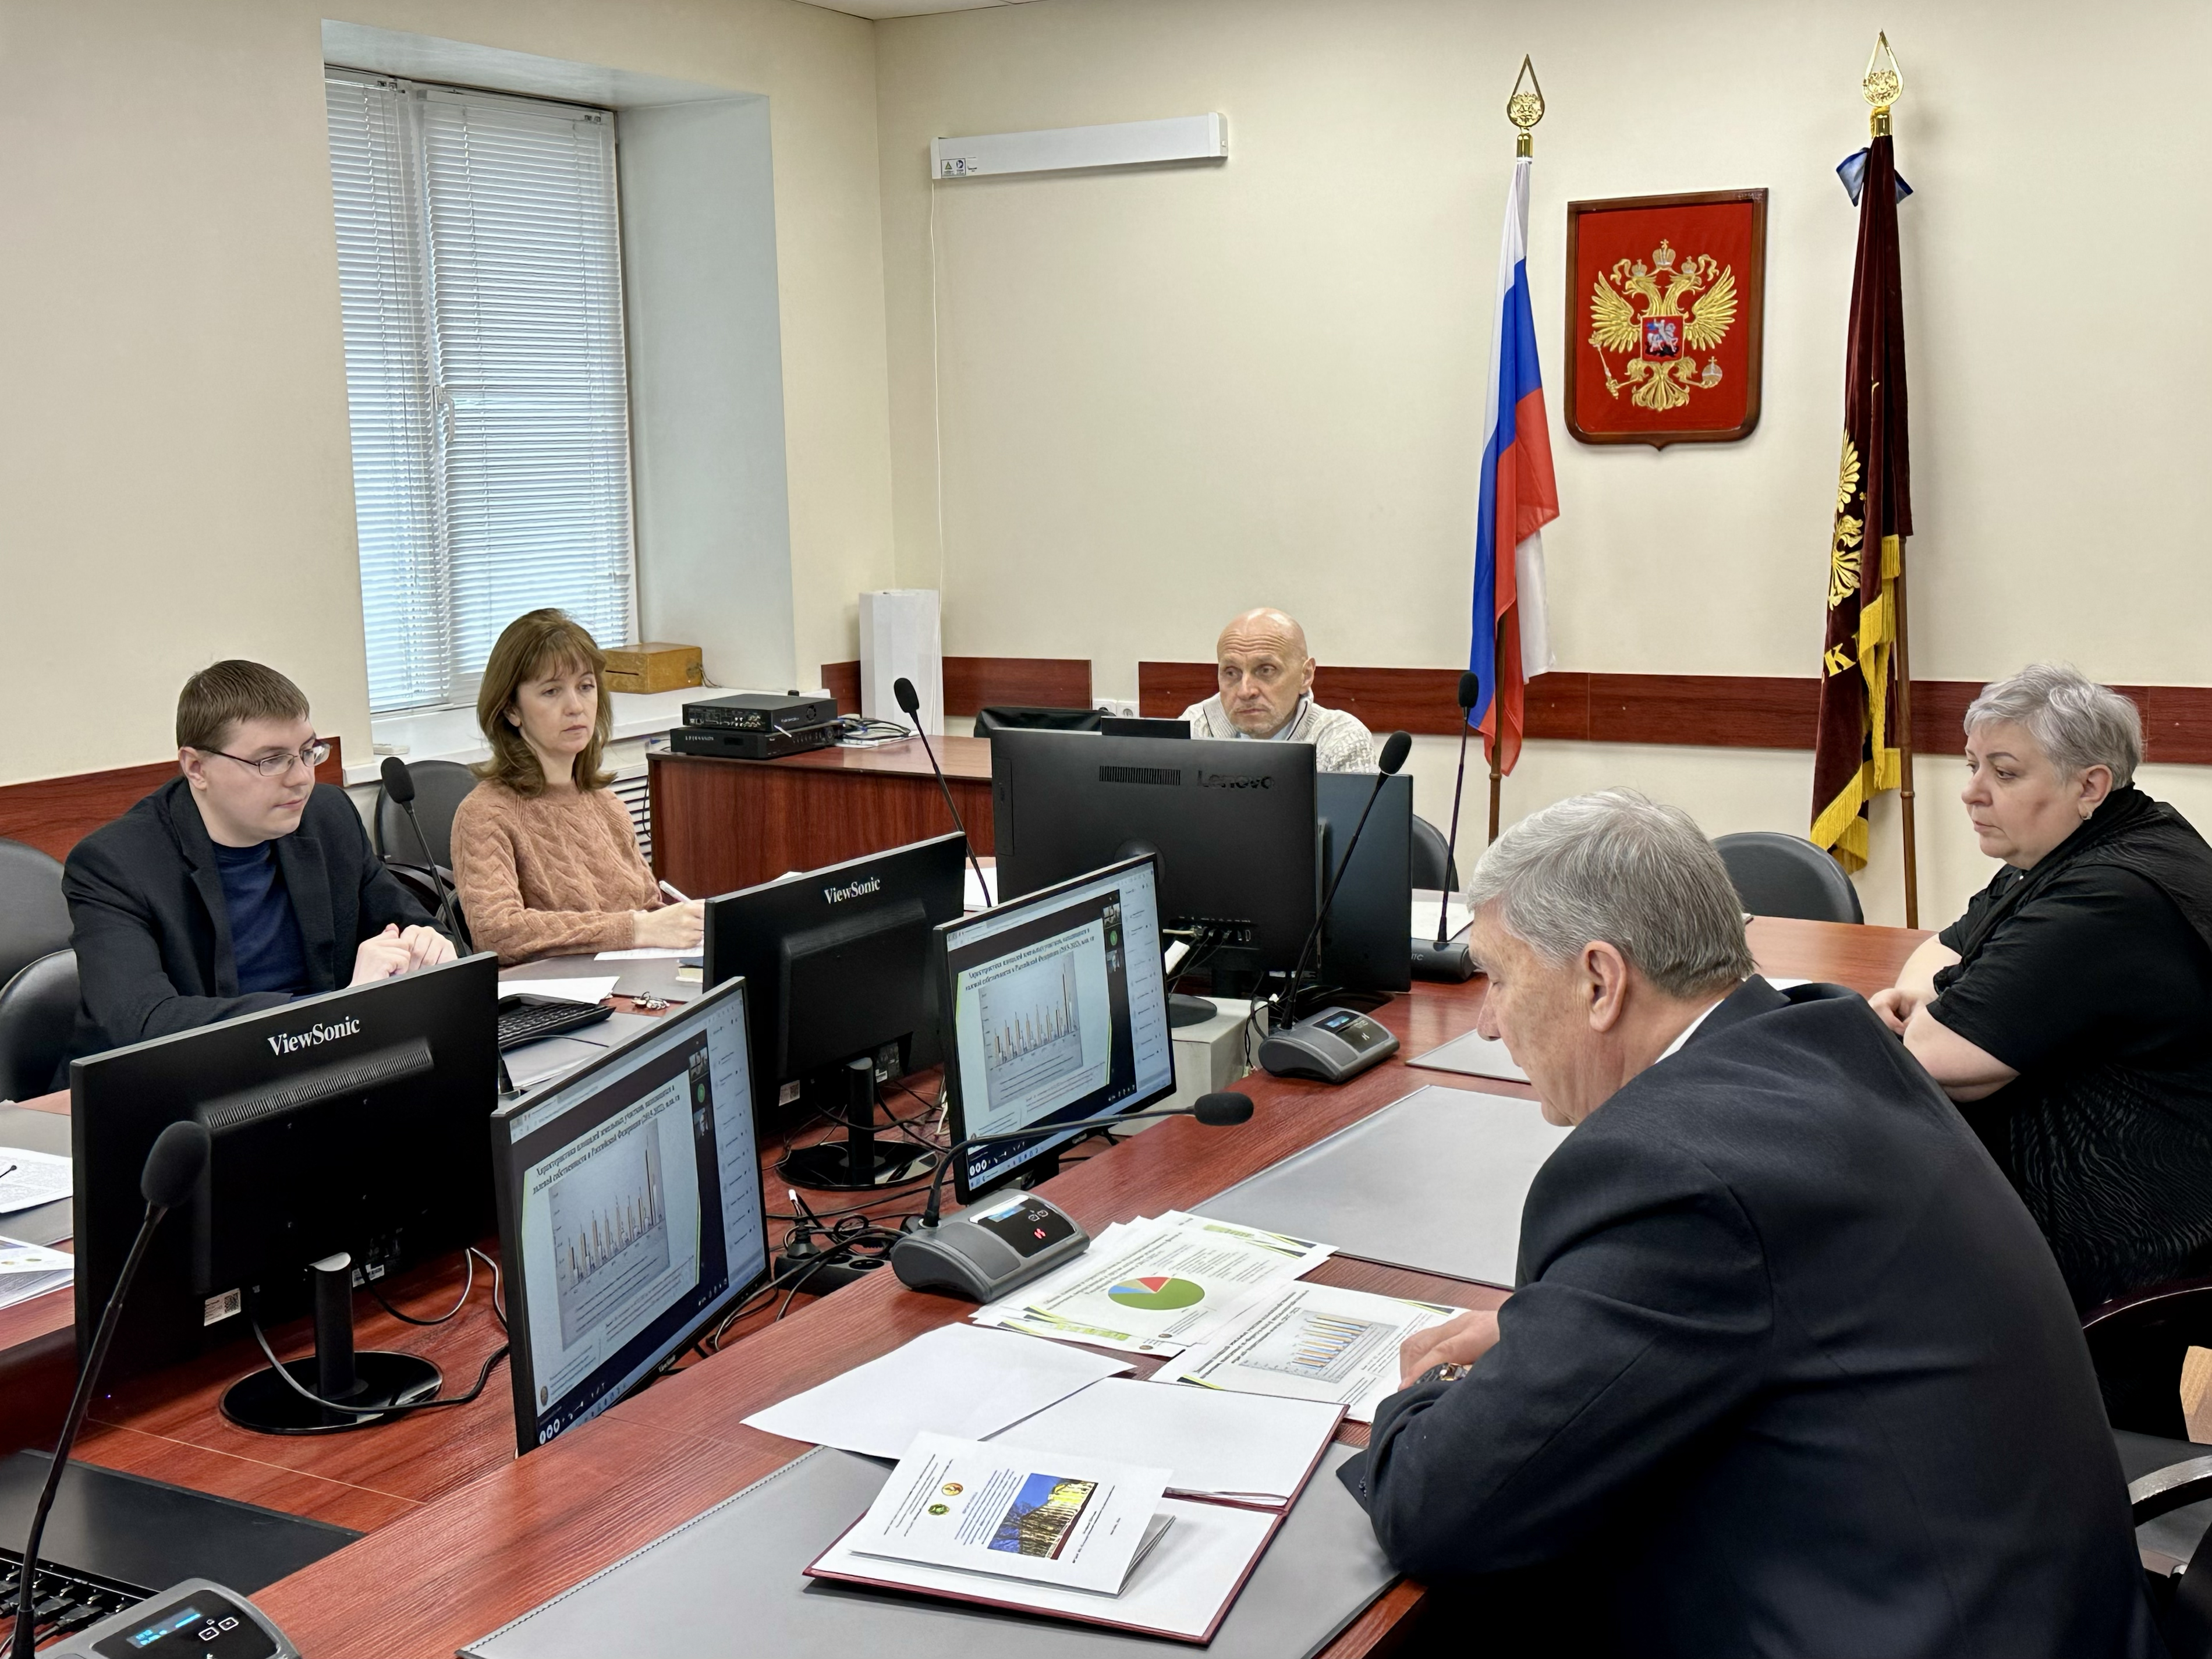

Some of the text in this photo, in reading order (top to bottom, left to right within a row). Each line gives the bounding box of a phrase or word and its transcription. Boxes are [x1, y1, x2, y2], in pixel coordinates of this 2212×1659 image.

[1197, 770, 1275, 790] Lenovo
[824, 876, 880, 905] ViewSonic
[267, 1016, 360, 1056] ViewSonic
